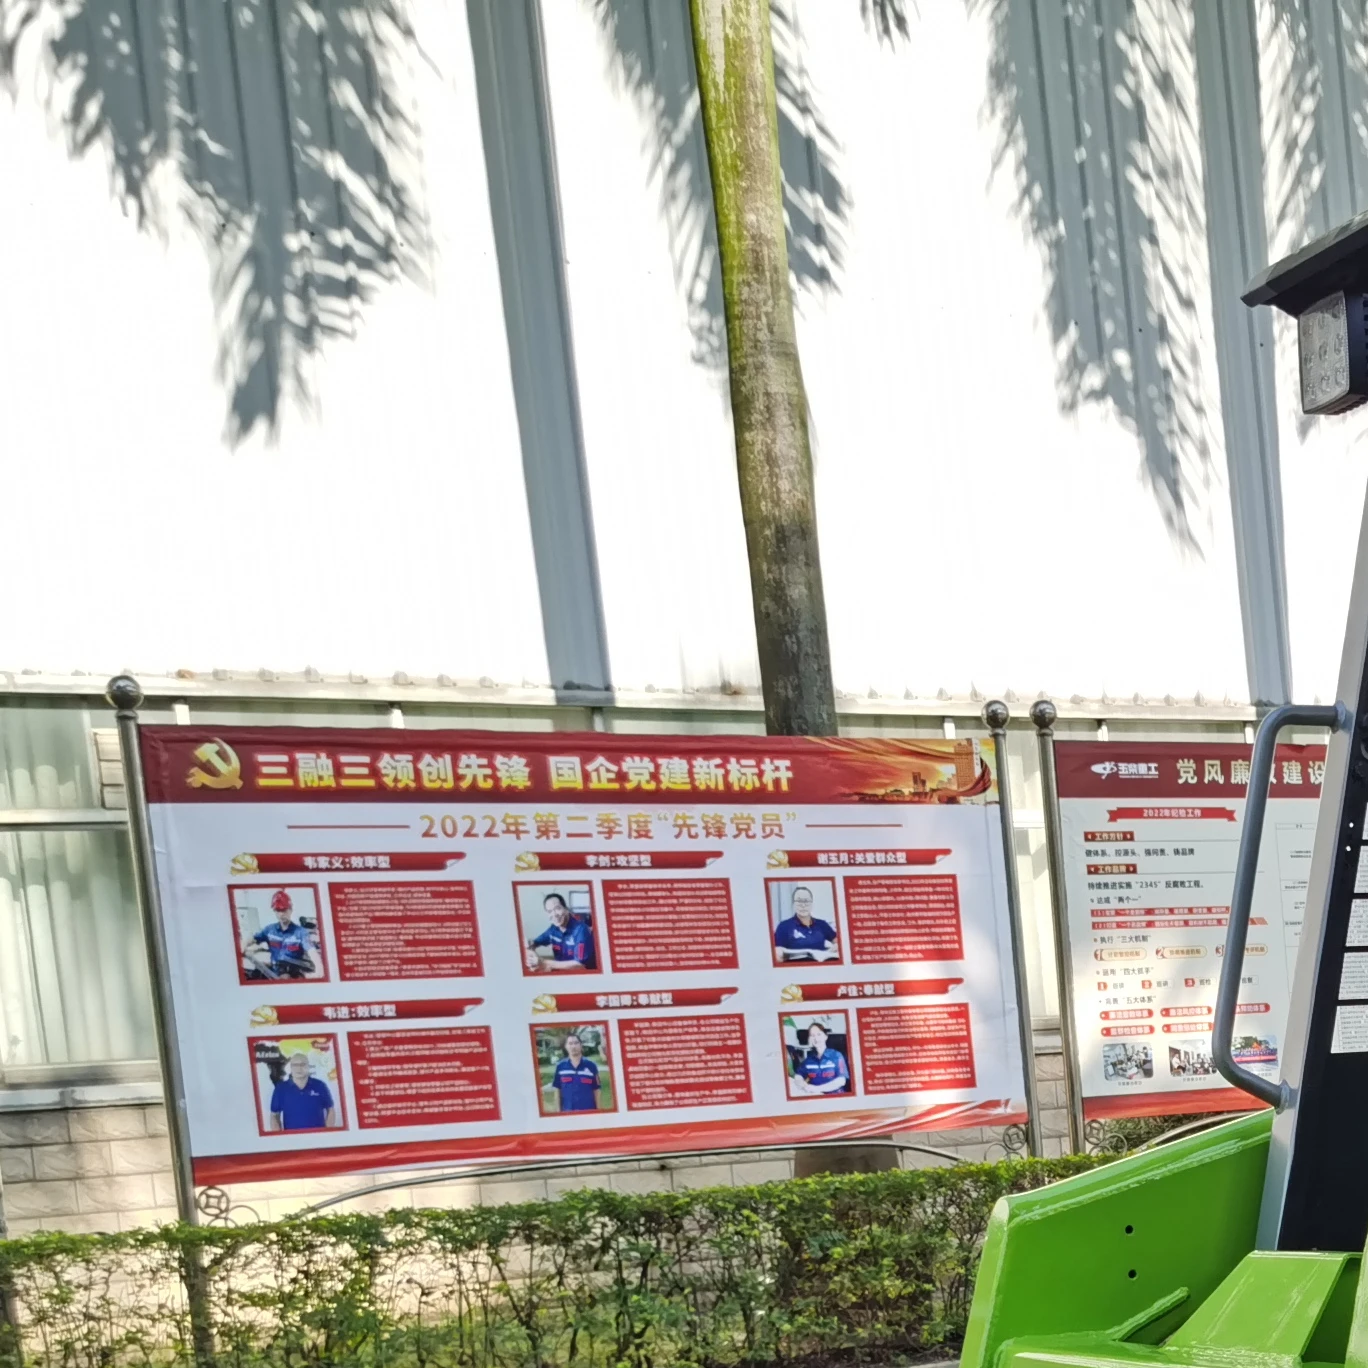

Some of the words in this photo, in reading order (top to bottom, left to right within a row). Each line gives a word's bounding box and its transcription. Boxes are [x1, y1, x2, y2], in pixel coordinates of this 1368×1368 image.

[256, 752, 531, 790] 三融三领创先锋
[547, 754, 794, 793] 国企党建新标杆
[419, 811, 797, 841] 2022年第二季度“先锋党员”
